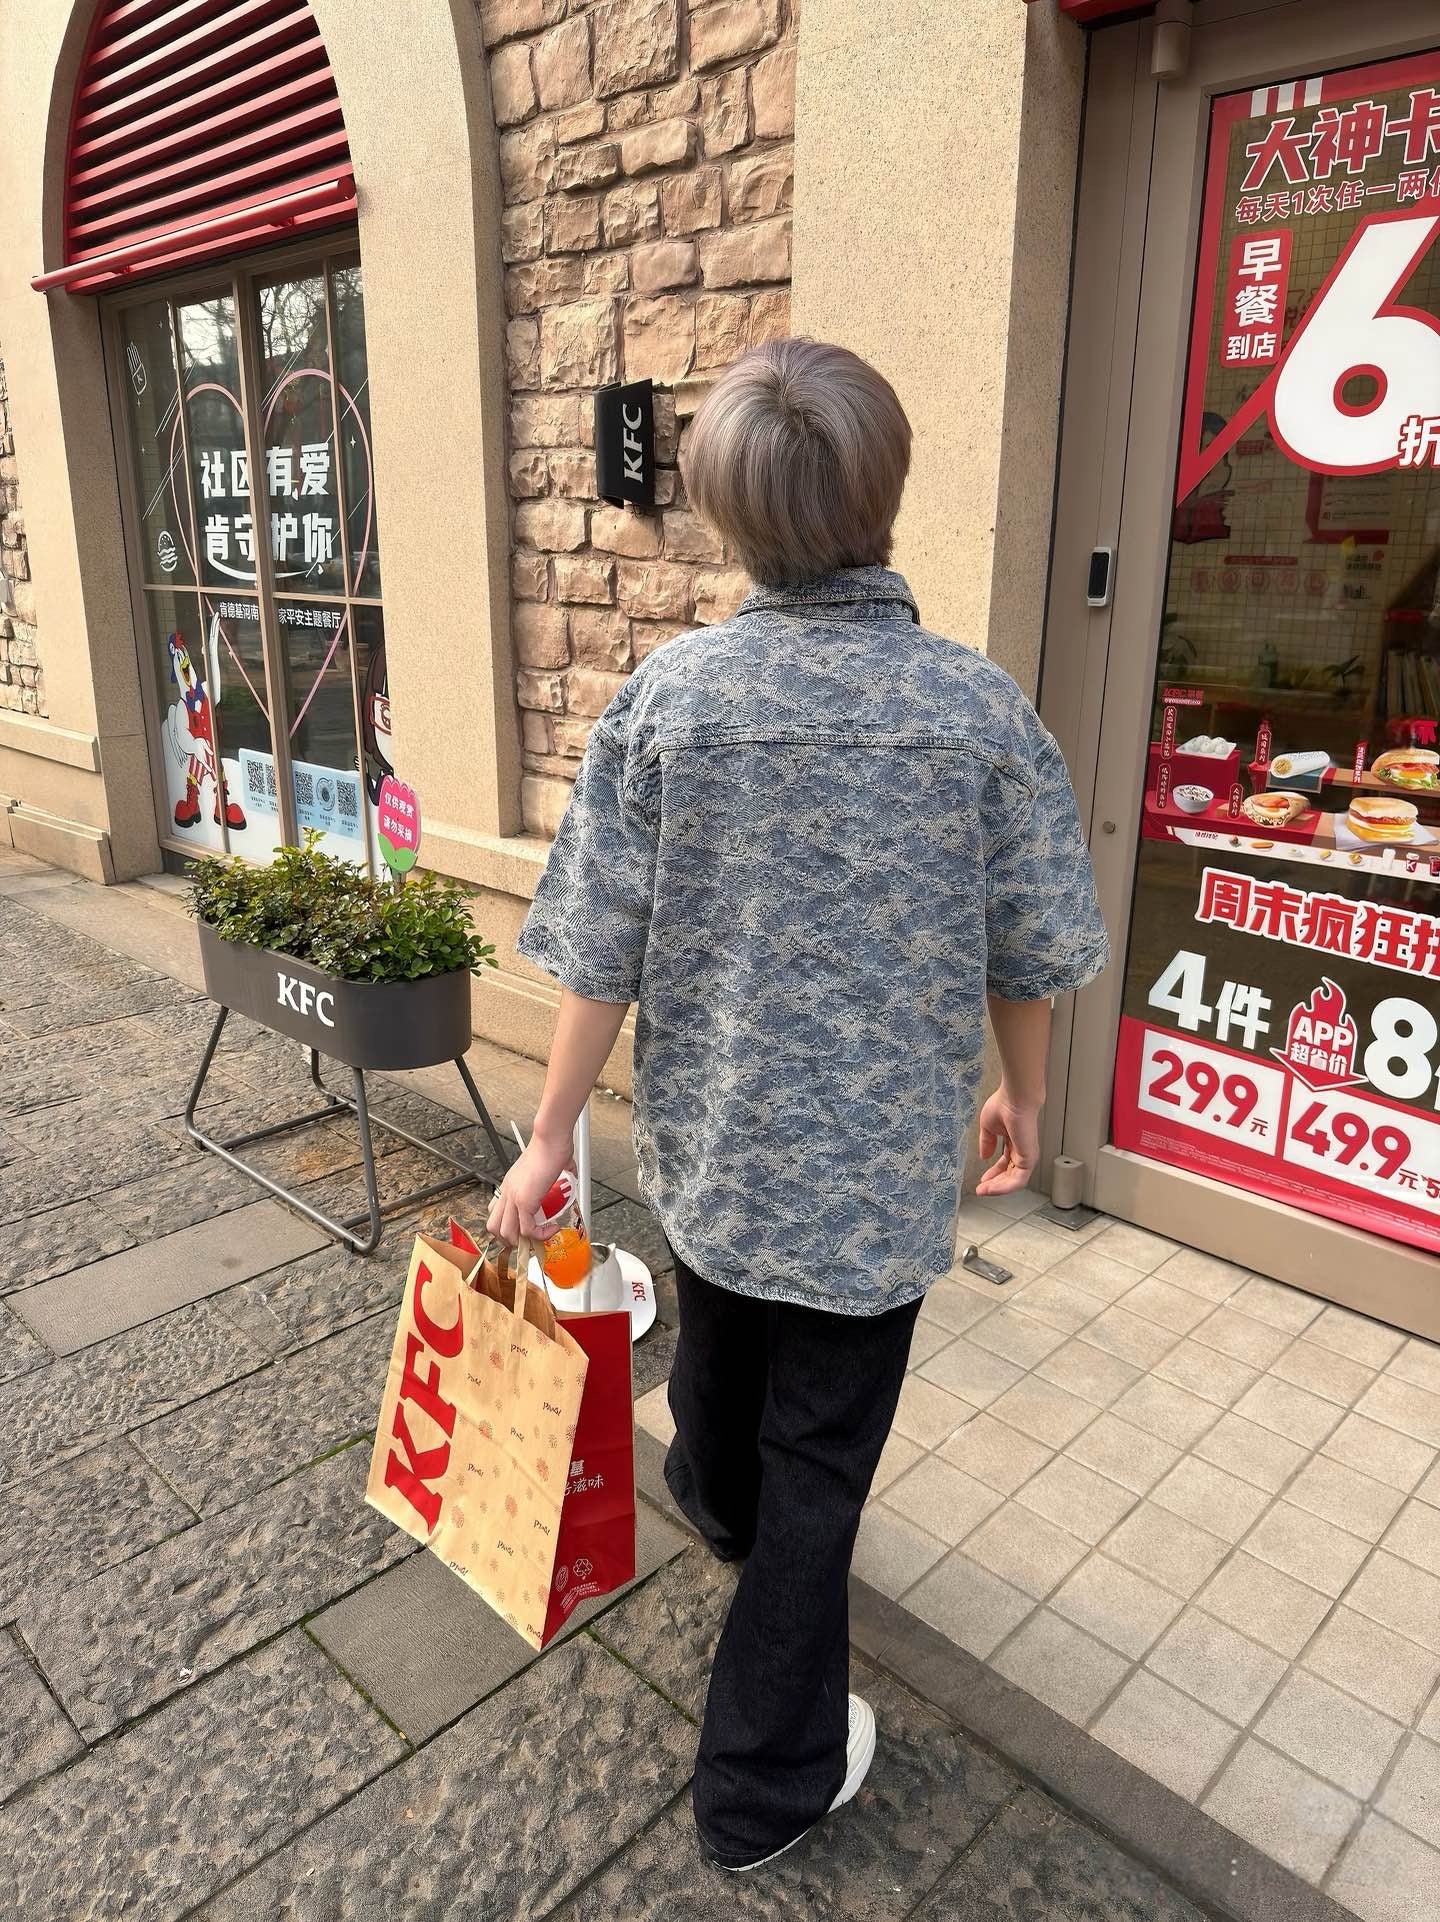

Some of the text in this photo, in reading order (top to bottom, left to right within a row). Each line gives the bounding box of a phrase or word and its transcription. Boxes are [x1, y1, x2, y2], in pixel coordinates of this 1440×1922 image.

[1240, 88, 1440, 191] 大神卡
[1234, 238, 1282, 328] 早餐
[1226, 332, 1277, 361] 到店
[200, 442, 330, 499] 社区有爱
[622, 403, 643, 484] KFC
[204, 512, 334, 563] 肯守护你
[276, 972, 335, 1028] KFC
[1290, 1041, 1348, 1078] 超省价
[1292, 1015, 1354, 1052] APP
[1363, 997, 1440, 1111] 8
[631, 1281, 646, 1302] KFC
[384, 1260, 464, 1535] KFC
